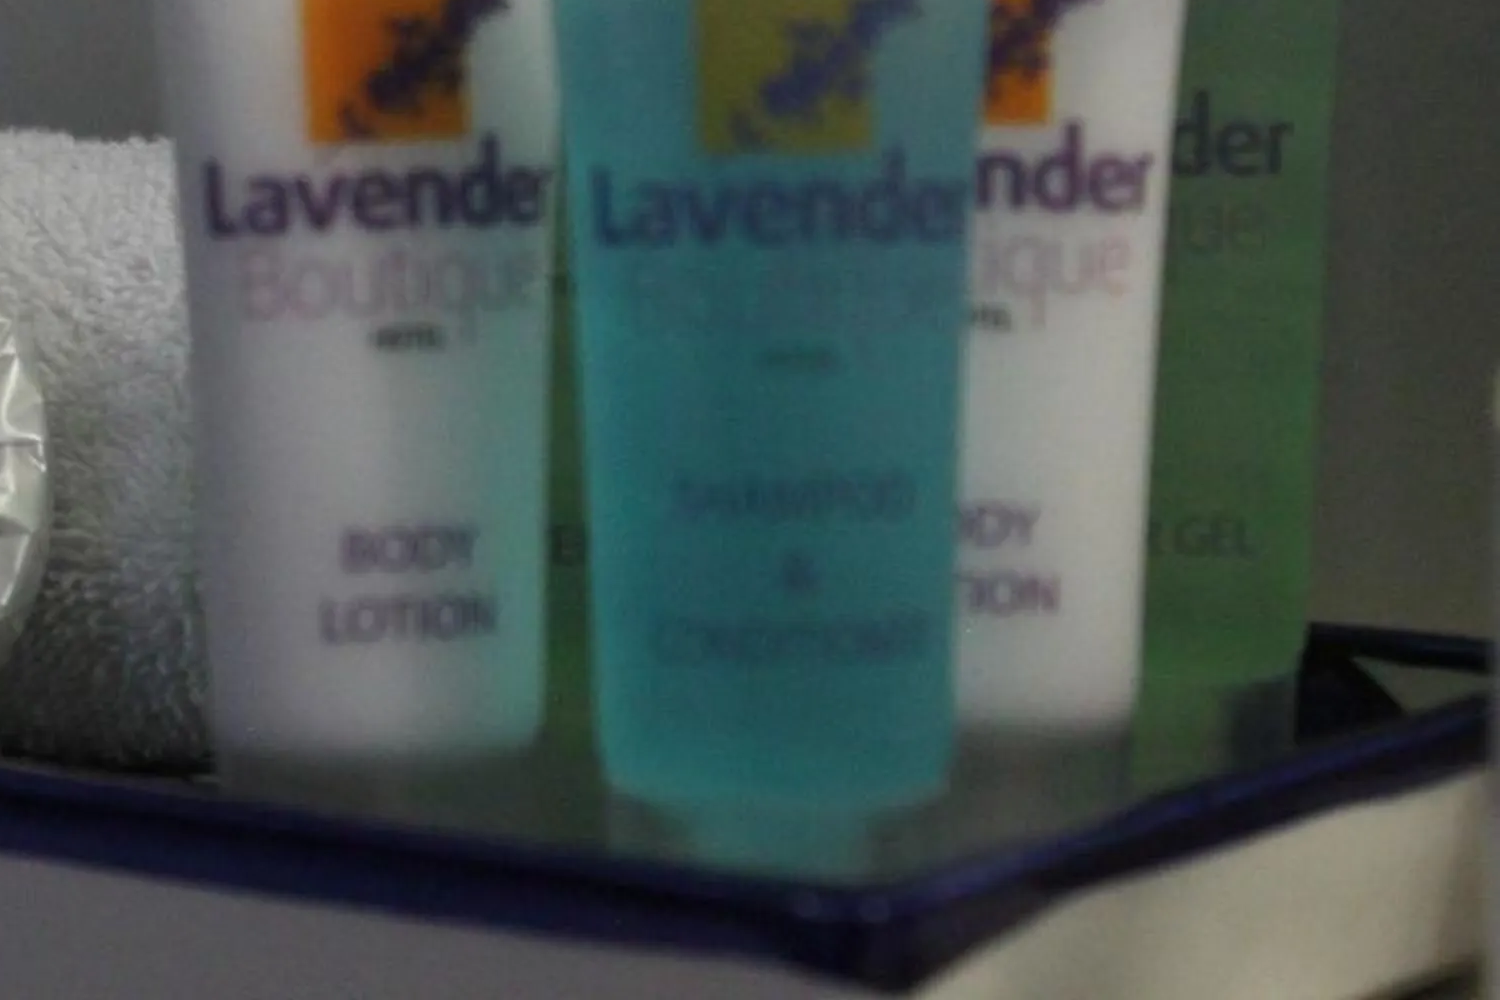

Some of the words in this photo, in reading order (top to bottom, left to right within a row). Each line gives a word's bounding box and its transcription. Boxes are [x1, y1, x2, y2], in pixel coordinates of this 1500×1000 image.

[976, 120, 1153, 213] nder
[981, 234, 1134, 326] ique
[341, 524, 479, 574] BODY
[319, 594, 498, 645] LOTION
